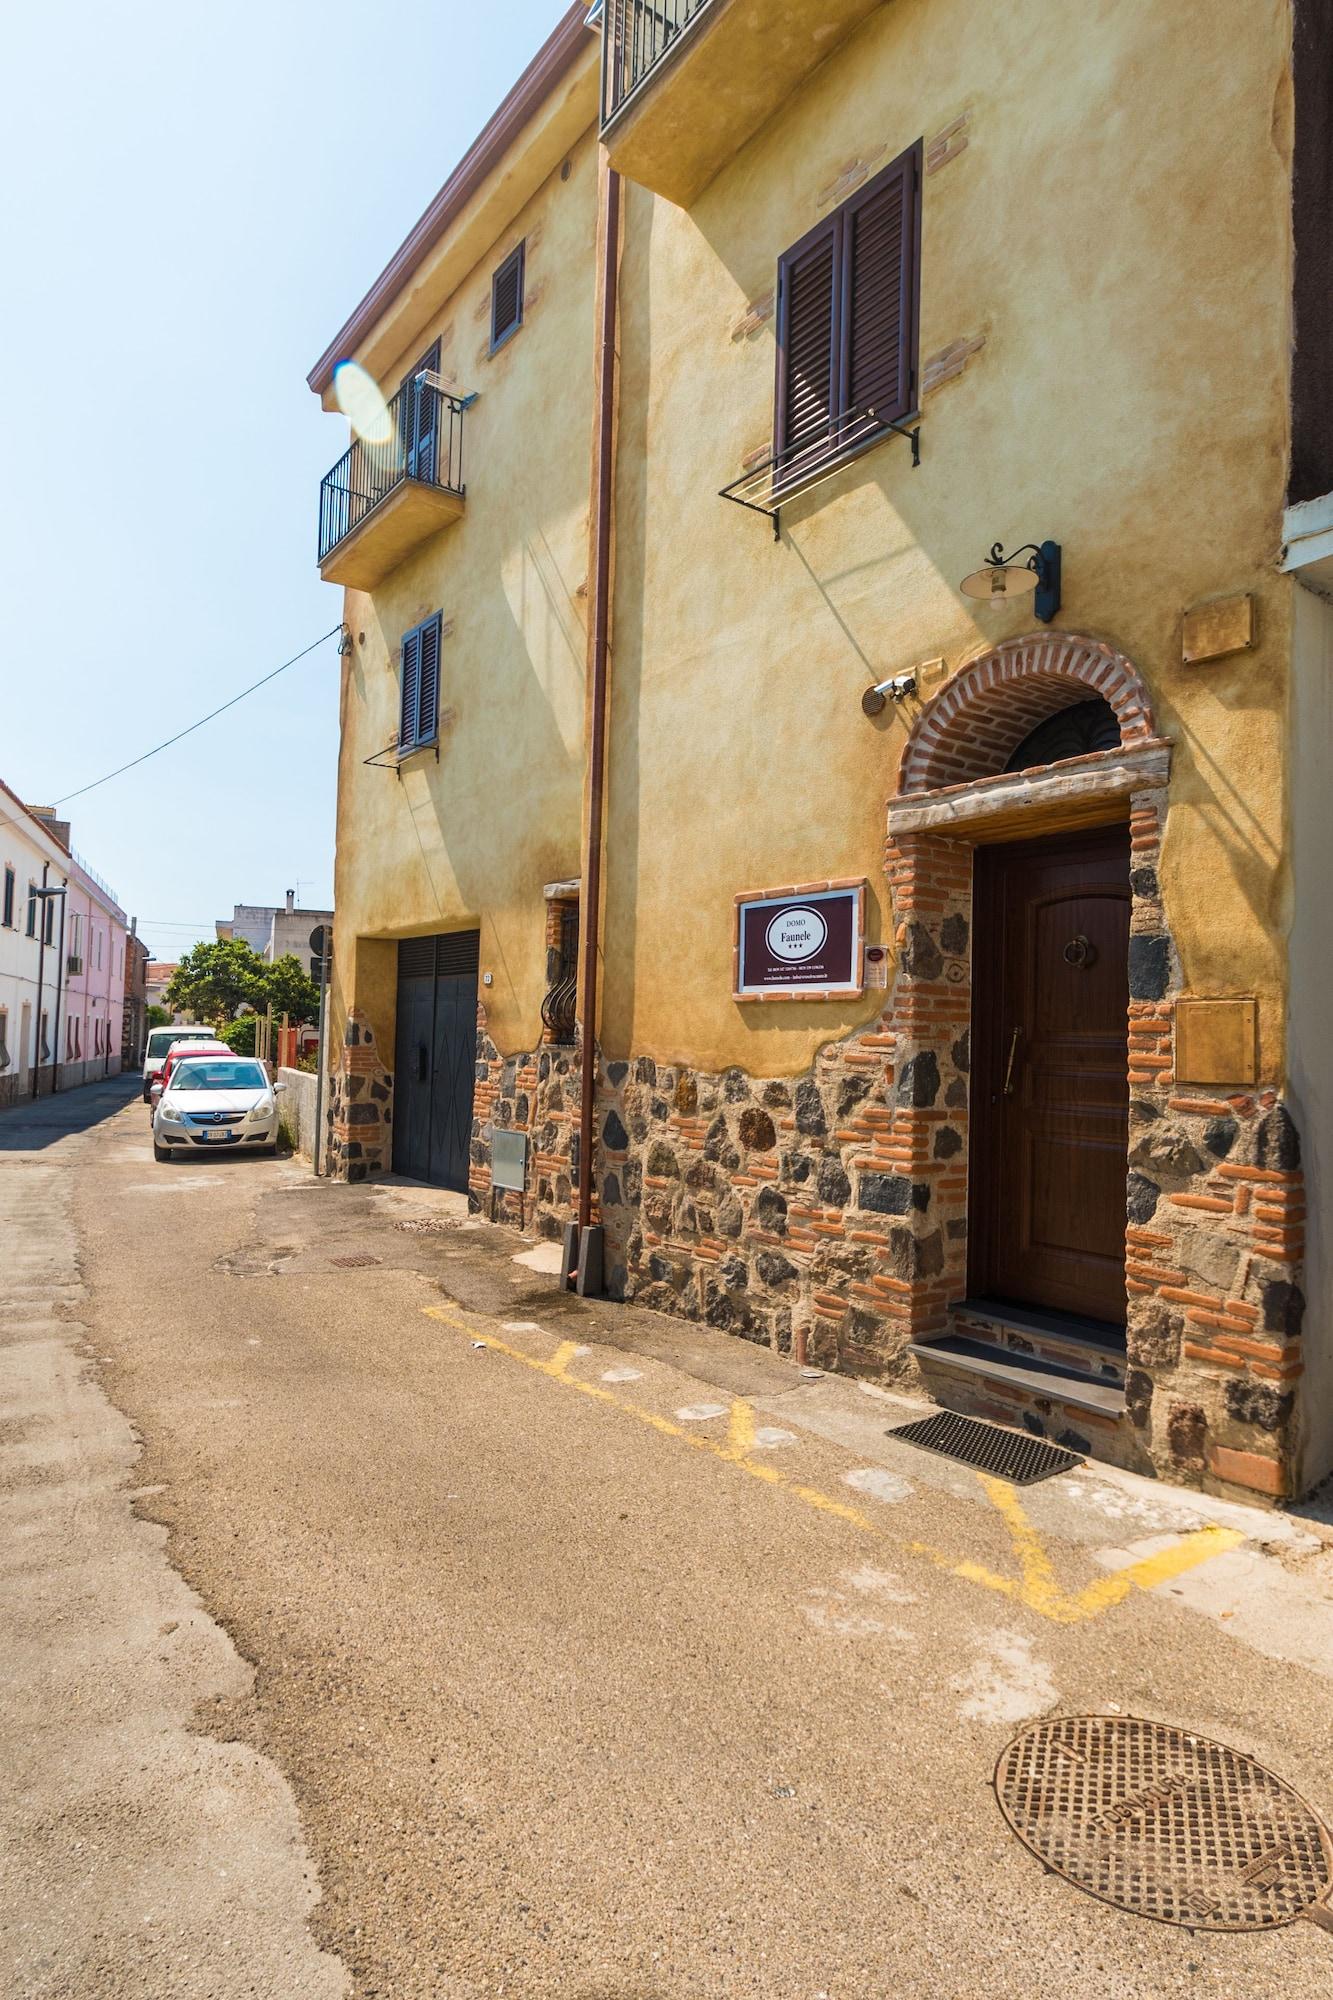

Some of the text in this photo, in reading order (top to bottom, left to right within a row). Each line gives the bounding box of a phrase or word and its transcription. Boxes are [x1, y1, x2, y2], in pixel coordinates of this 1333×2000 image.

[787, 919, 805, 927] DOMO
[781, 930, 811, 942] Faunele
[1091, 1773, 1192, 1831] FOGNATURA
